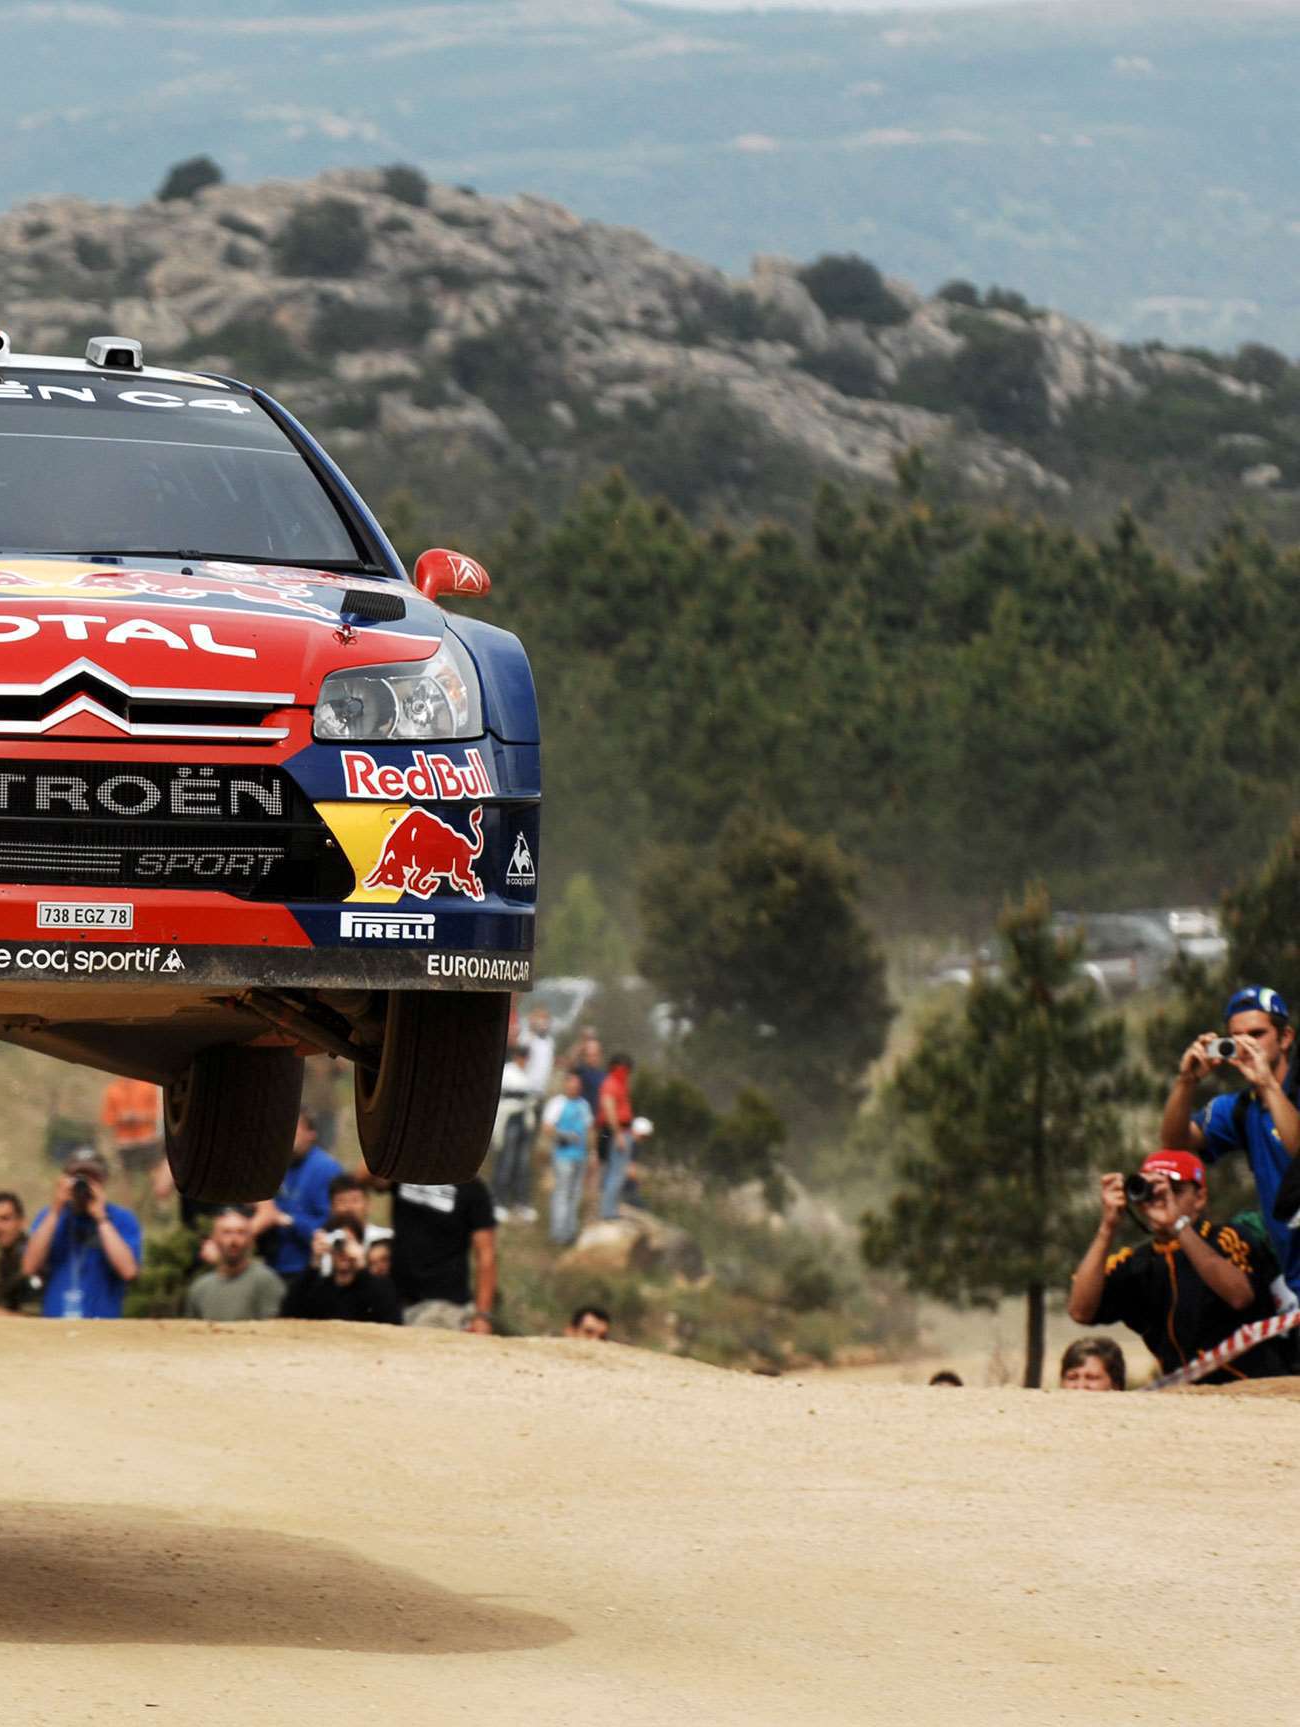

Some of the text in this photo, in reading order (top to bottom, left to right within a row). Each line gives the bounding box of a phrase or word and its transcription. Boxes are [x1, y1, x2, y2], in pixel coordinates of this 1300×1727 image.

[117, 391, 251, 415] C4
[134, 853, 284, 877] SPORT
[44, 907, 128, 924] 738 EGZ 78
[340, 911, 436, 940] PIRELLI
[15, 948, 69, 973] coq
[73, 947, 161, 974] sportif
[427, 954, 530, 982] EURODATACAR
